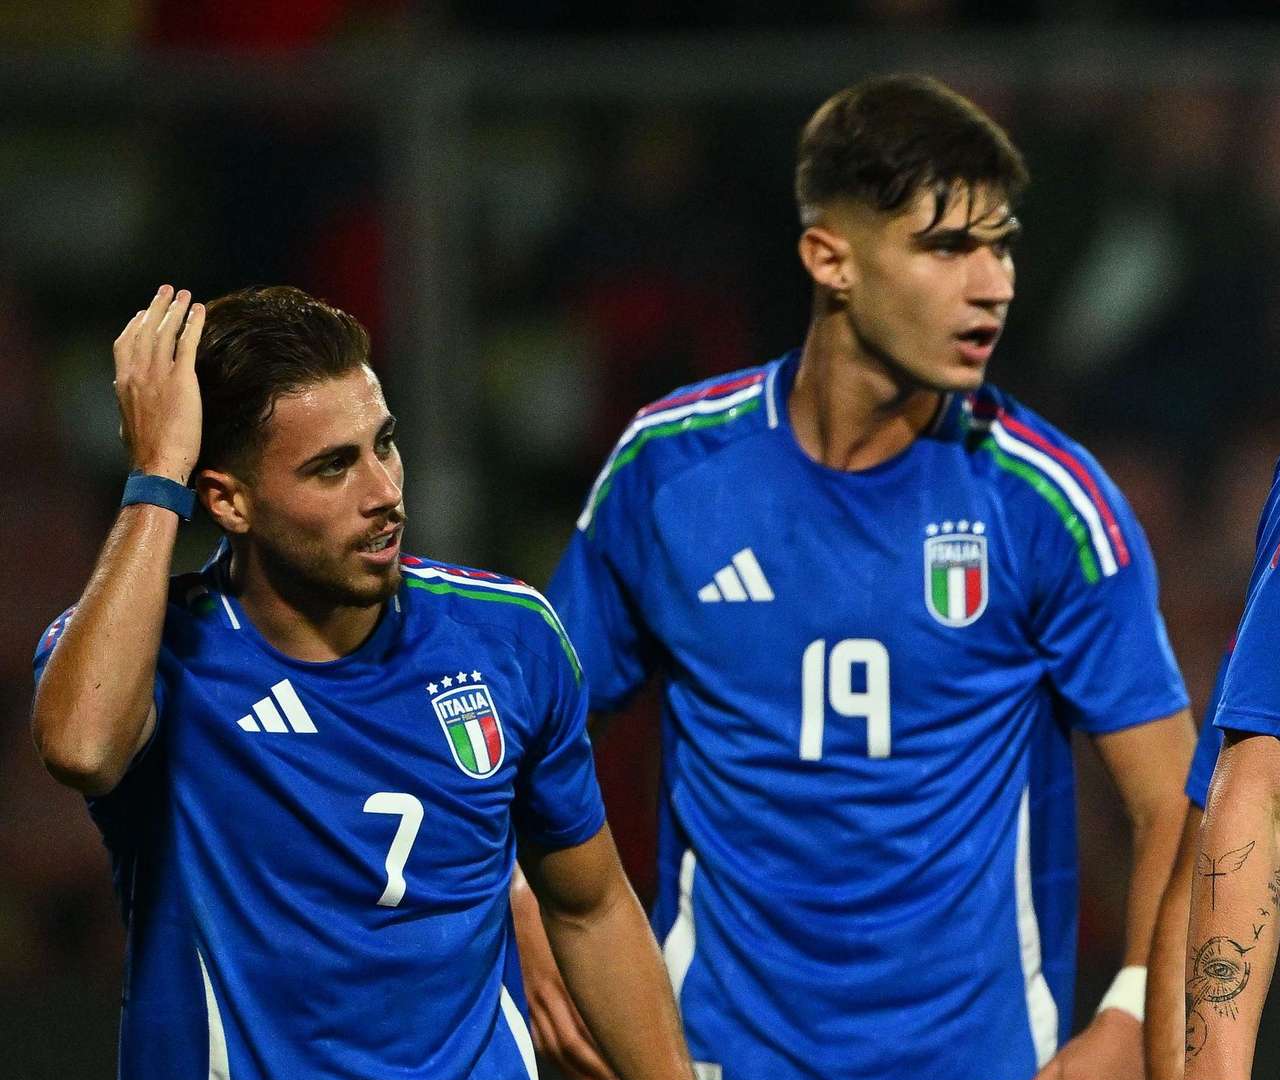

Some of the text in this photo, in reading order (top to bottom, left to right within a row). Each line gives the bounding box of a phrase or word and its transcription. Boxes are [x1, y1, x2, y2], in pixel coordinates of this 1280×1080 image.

[438, 691, 489, 719] ITALIA
[800, 638, 891, 761] 19
[363, 792, 425, 906] 7
